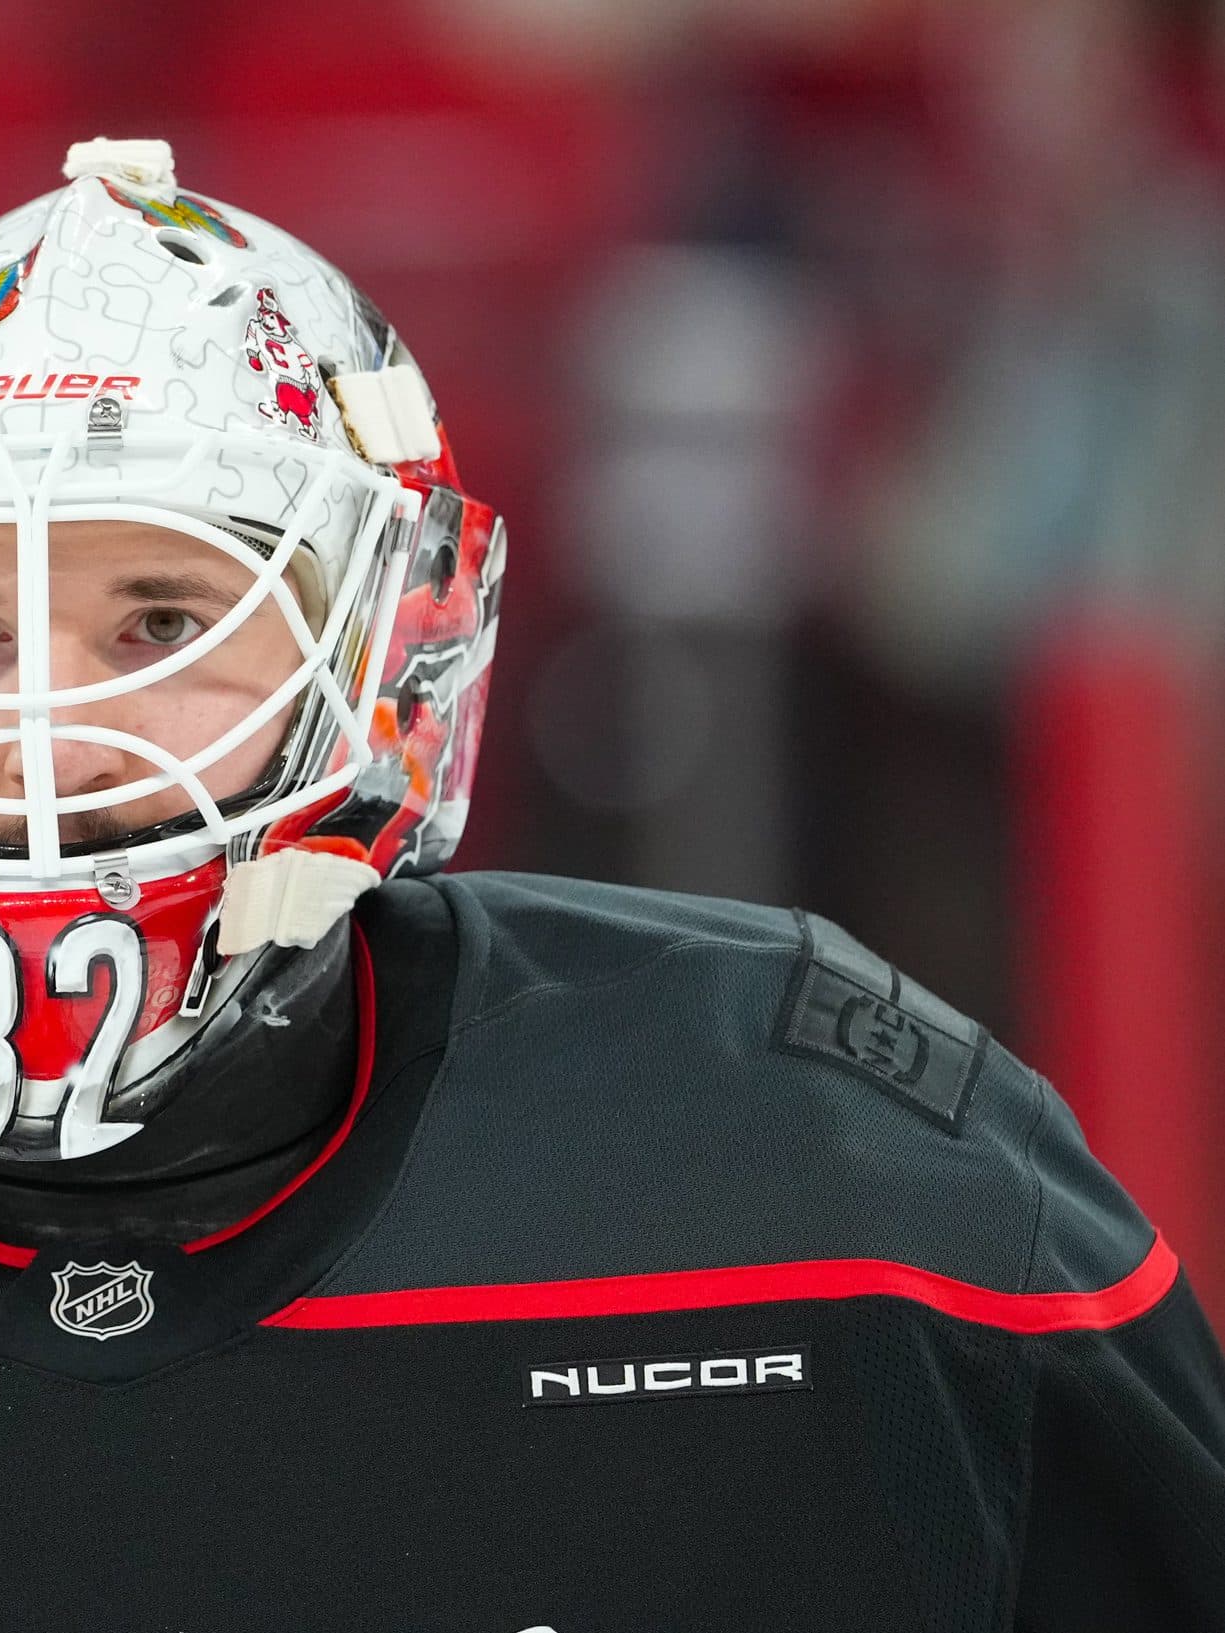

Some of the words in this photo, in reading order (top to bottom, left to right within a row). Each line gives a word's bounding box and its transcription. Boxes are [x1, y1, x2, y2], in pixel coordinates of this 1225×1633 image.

[265, 338, 290, 369] C
[75, 1282, 133, 1322] NHL
[530, 1354, 803, 1398] NUCOR
